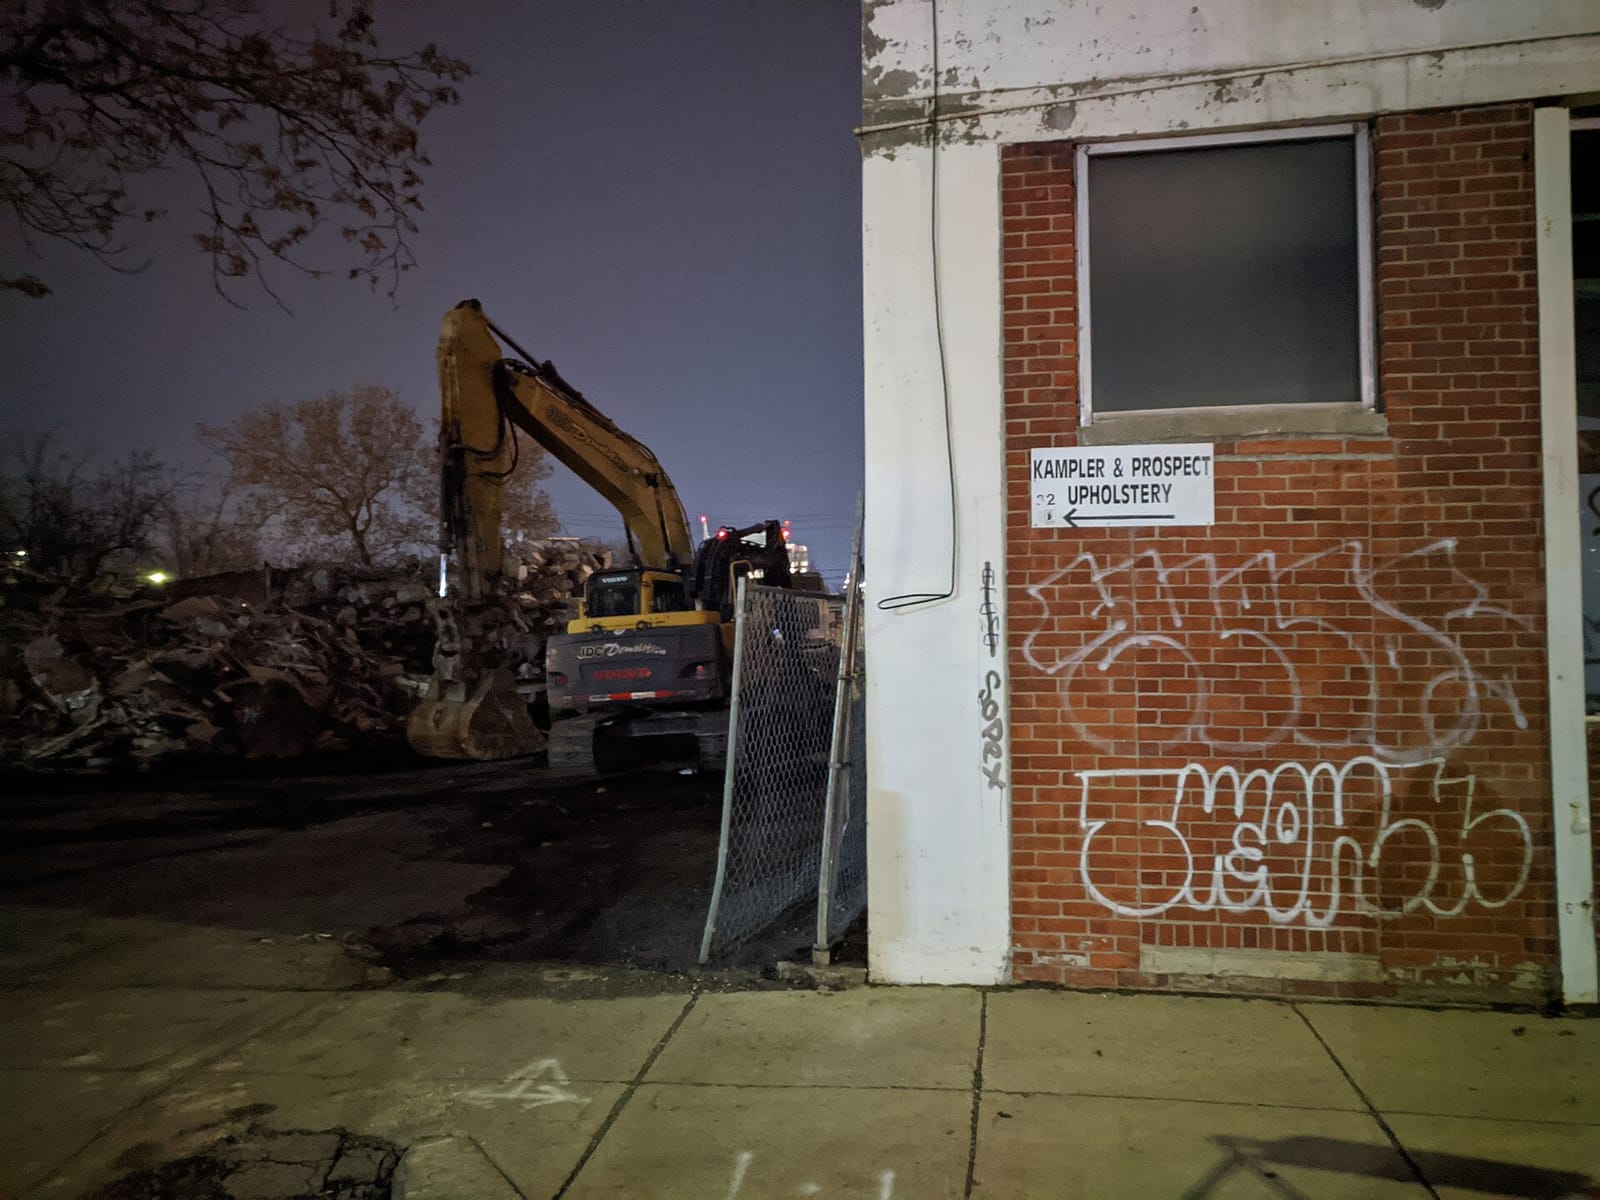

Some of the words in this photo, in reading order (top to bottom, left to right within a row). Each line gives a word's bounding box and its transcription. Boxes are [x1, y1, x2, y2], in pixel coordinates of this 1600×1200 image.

[1033, 459, 1105, 479] KAMPLER
[1113, 458, 1124, 478] &
[1132, 456, 1211, 476] PROSPECT
[1067, 483, 1173, 505] UPHOLSTERY
